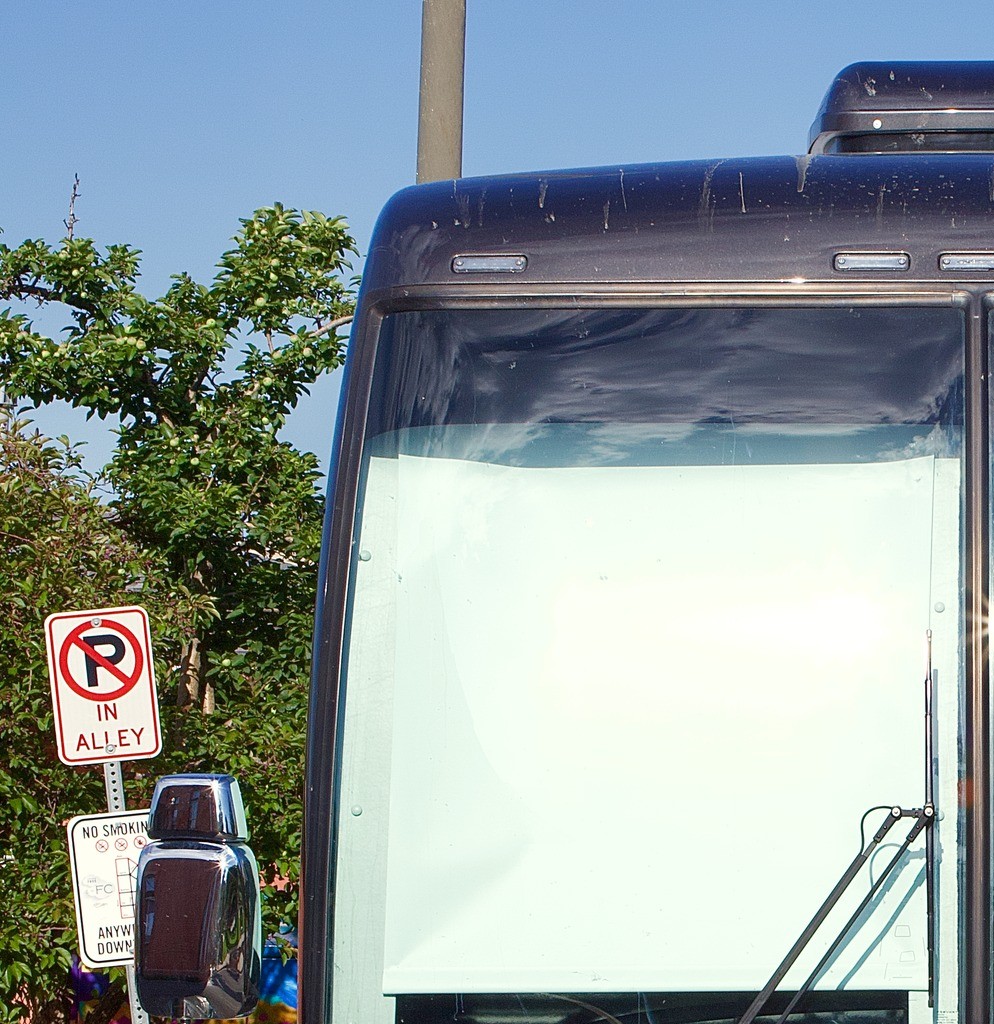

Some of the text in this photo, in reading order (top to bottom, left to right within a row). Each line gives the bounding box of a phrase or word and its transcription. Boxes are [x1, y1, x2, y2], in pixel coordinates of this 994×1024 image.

[97, 703, 118, 722] IN
[76, 727, 145, 752] ALLEY
[82, 820, 148, 839] NO SMOKIN
[97, 939, 135, 955] DOWN
